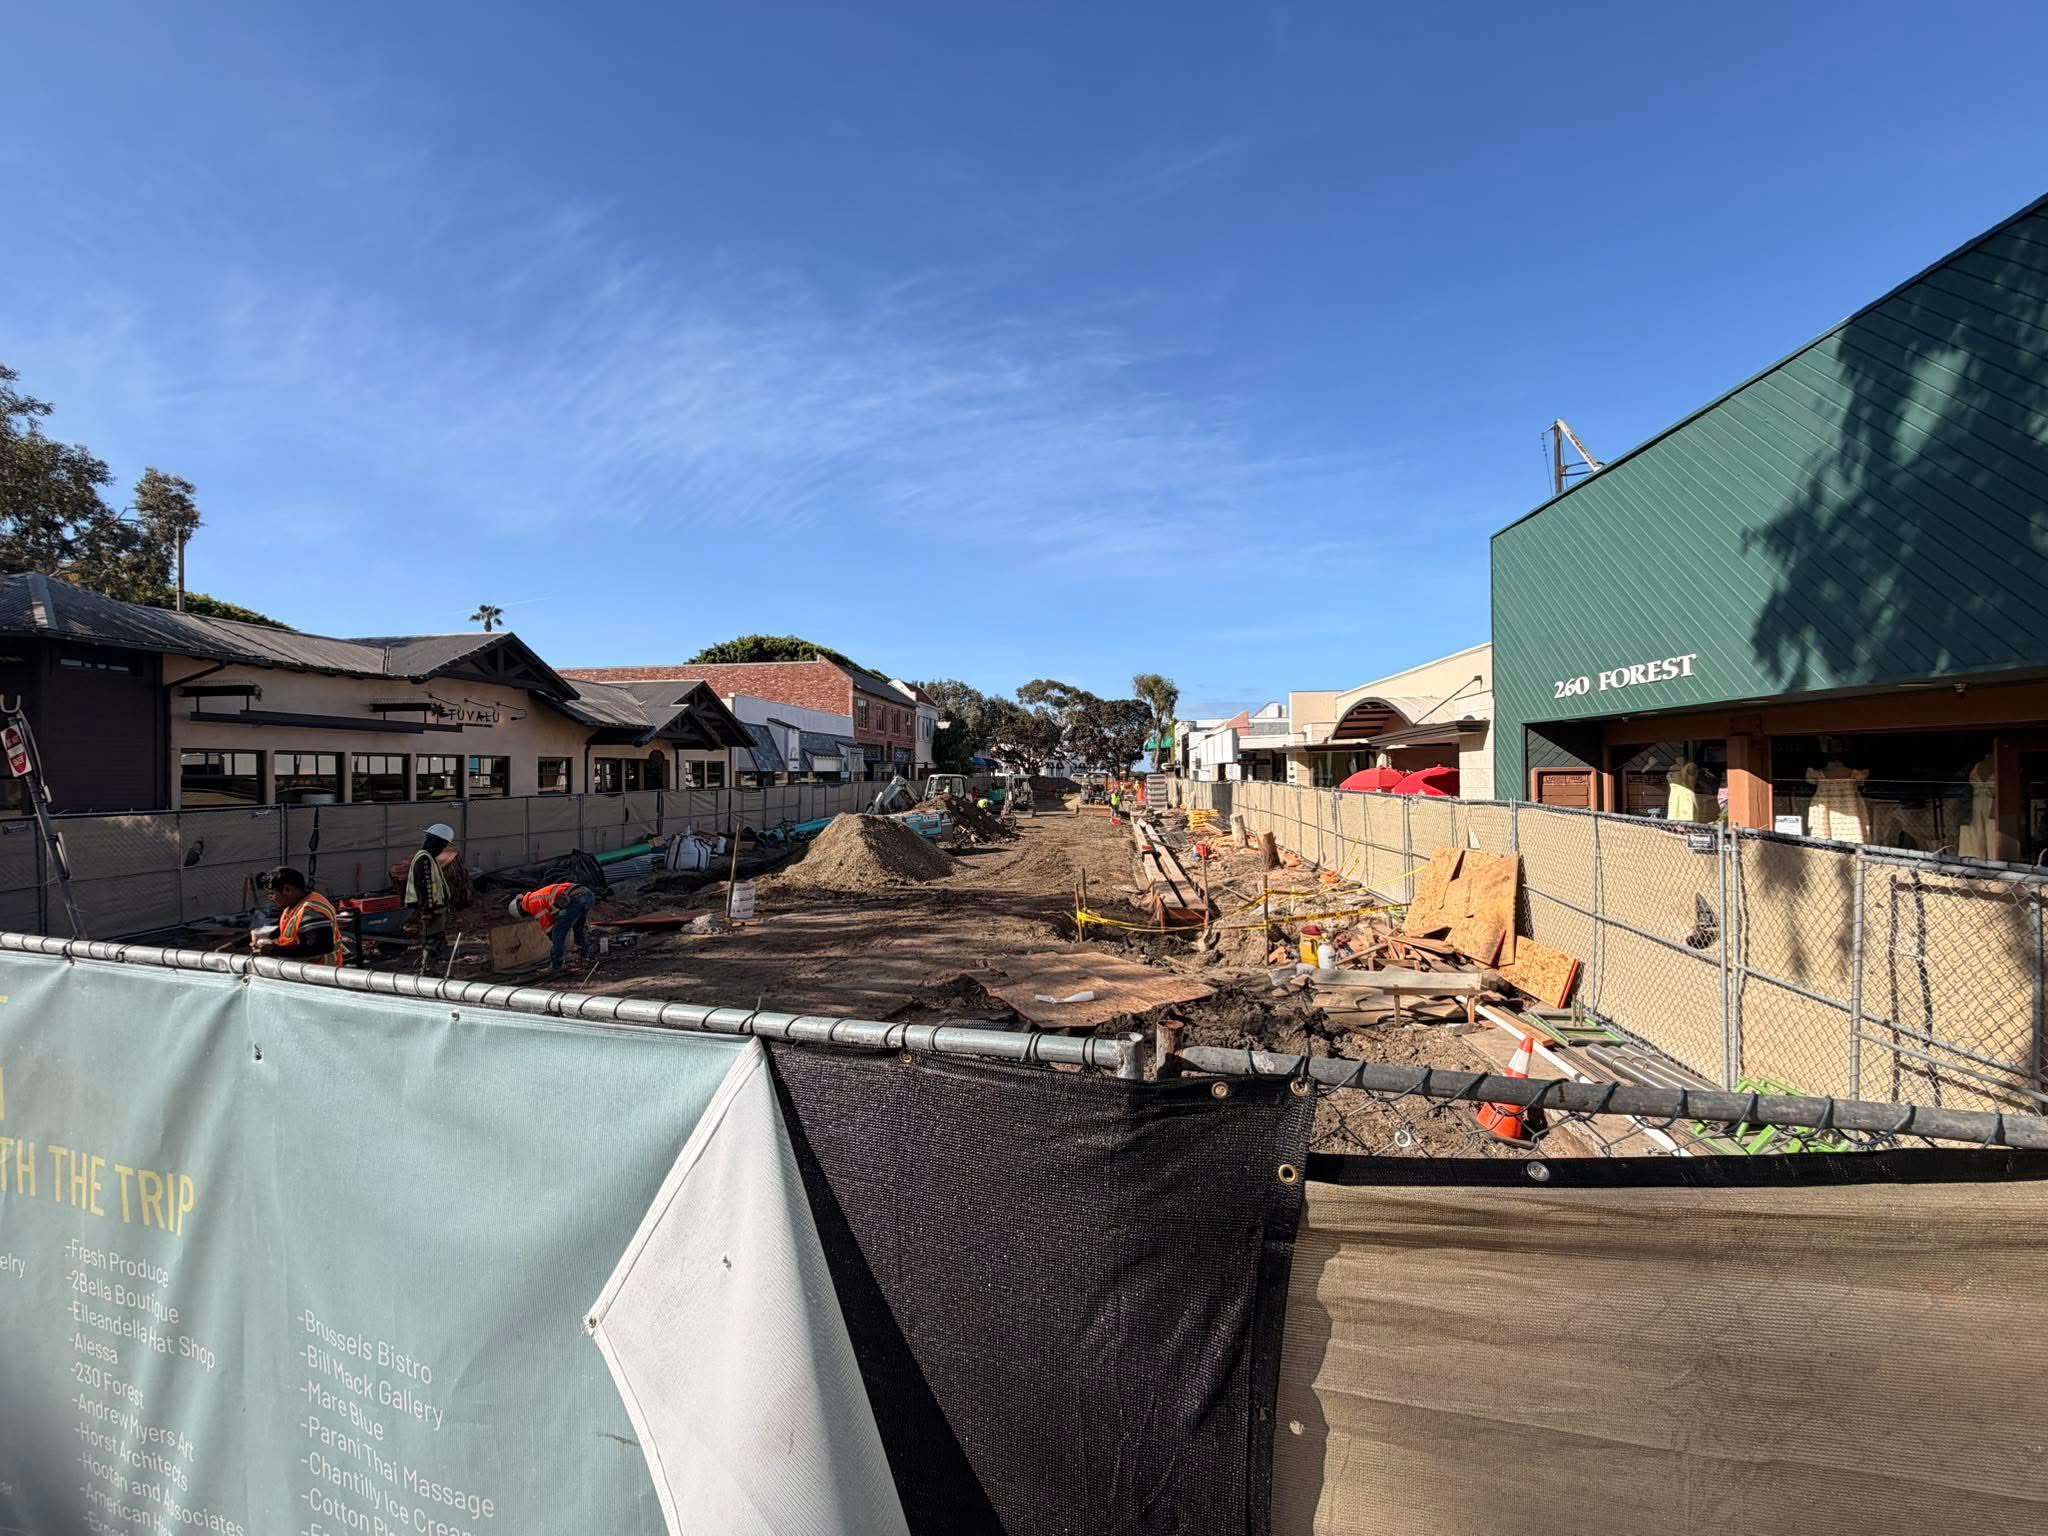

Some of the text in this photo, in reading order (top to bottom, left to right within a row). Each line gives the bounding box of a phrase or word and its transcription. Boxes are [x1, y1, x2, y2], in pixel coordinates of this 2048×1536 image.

[1553, 653, 1697, 699] 260 FOREST
[448, 709, 500, 723] TUVALU
[48, 1144, 105, 1217] THE
[114, 1163, 196, 1237] TRIP
[109, 1251, 169, 1288] Produce
[115, 1284, 180, 1325] Boutique
[69, 1332, 118, 1365] -Alessa
[147, 1325, 175, 1355] Hat
[179, 1335, 216, 1372] Shop
[297, 1309, 432, 1384] -Brussels Bistro
[103, 1371, 145, 1410] Forest
[332, 1357, 374, 1401] Mack
[378, 1380, 444, 1432] Gallery
[129, 1412, 176, 1446] Myers
[177, 1431, 195, 1463] Art
[349, 1400, 384, 1440] Blue
[119, 1440, 190, 1493] Architects
[301, 1451, 382, 1510] -Chantilly
[384, 1491, 409, 1525] Ice
[362, 1444, 399, 1485] Thai
[403, 1466, 495, 1520] Massage
[131, 1480, 161, 1503] and
